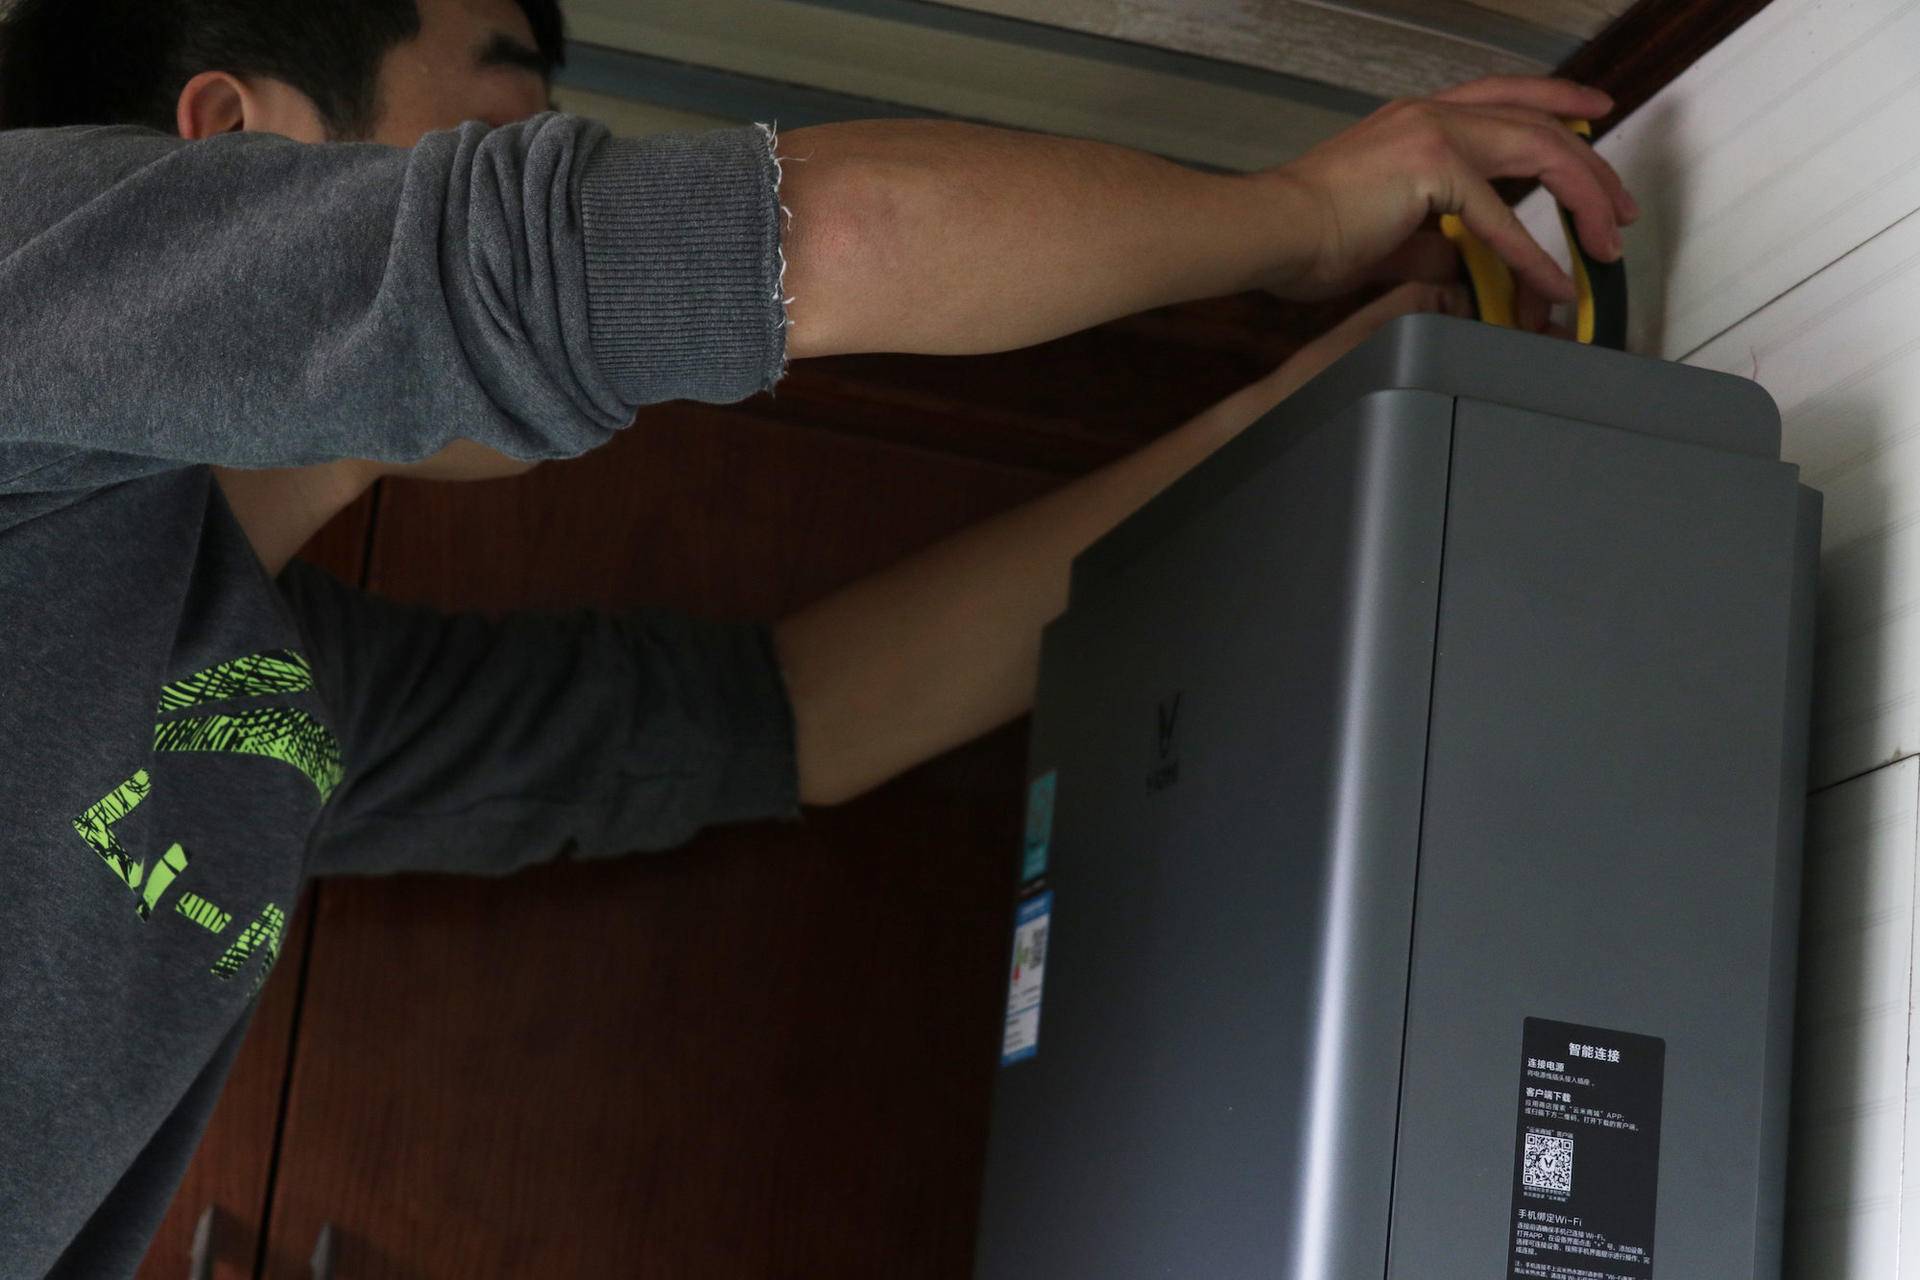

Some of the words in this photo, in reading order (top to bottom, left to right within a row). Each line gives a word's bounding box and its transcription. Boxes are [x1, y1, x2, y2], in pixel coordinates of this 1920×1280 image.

[1569, 1042, 1620, 1063] 智能连接
[1528, 1058, 1565, 1072] 连接电源
[1526, 1087, 1571, 1103] 客户端下载
[1519, 1209, 1582, 1227] 手机绑定Wi-Fi
